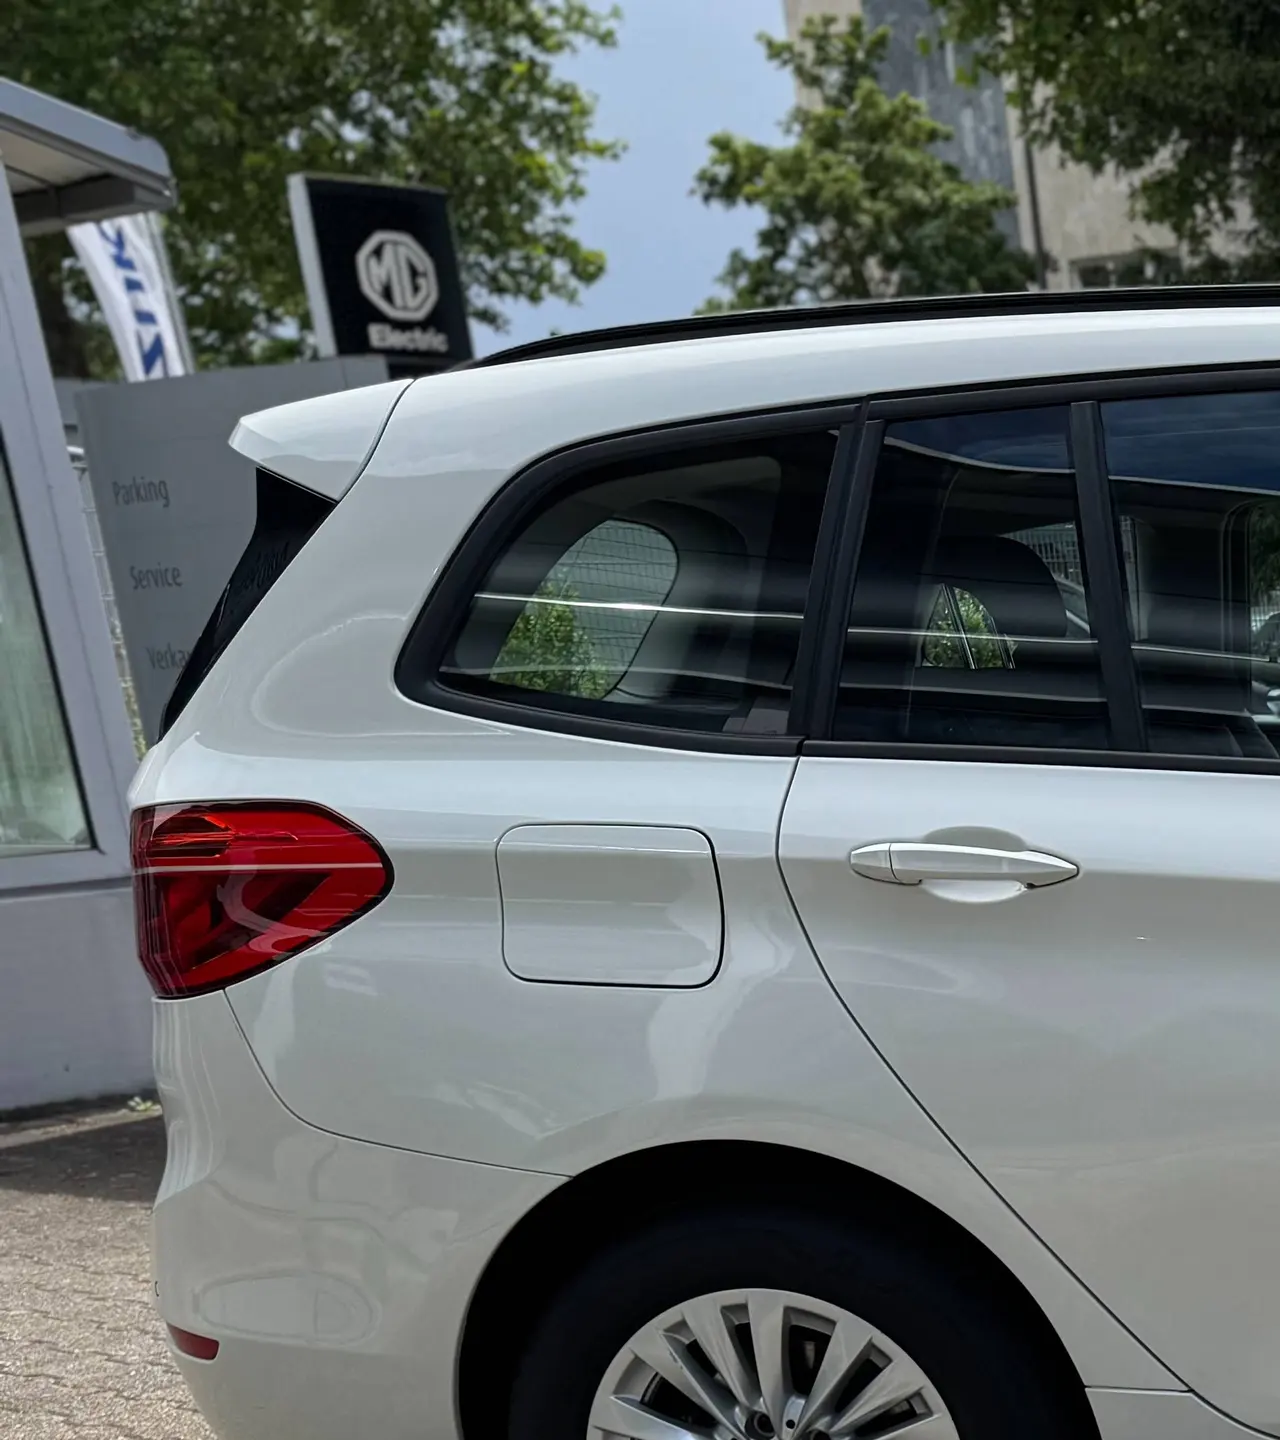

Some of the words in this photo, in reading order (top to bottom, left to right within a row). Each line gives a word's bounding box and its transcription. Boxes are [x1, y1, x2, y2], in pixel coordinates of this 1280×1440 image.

[365, 239, 431, 312] MG
[367, 322, 449, 353] Electric
[111, 476, 170, 508] Parking
[130, 563, 183, 590] Service
